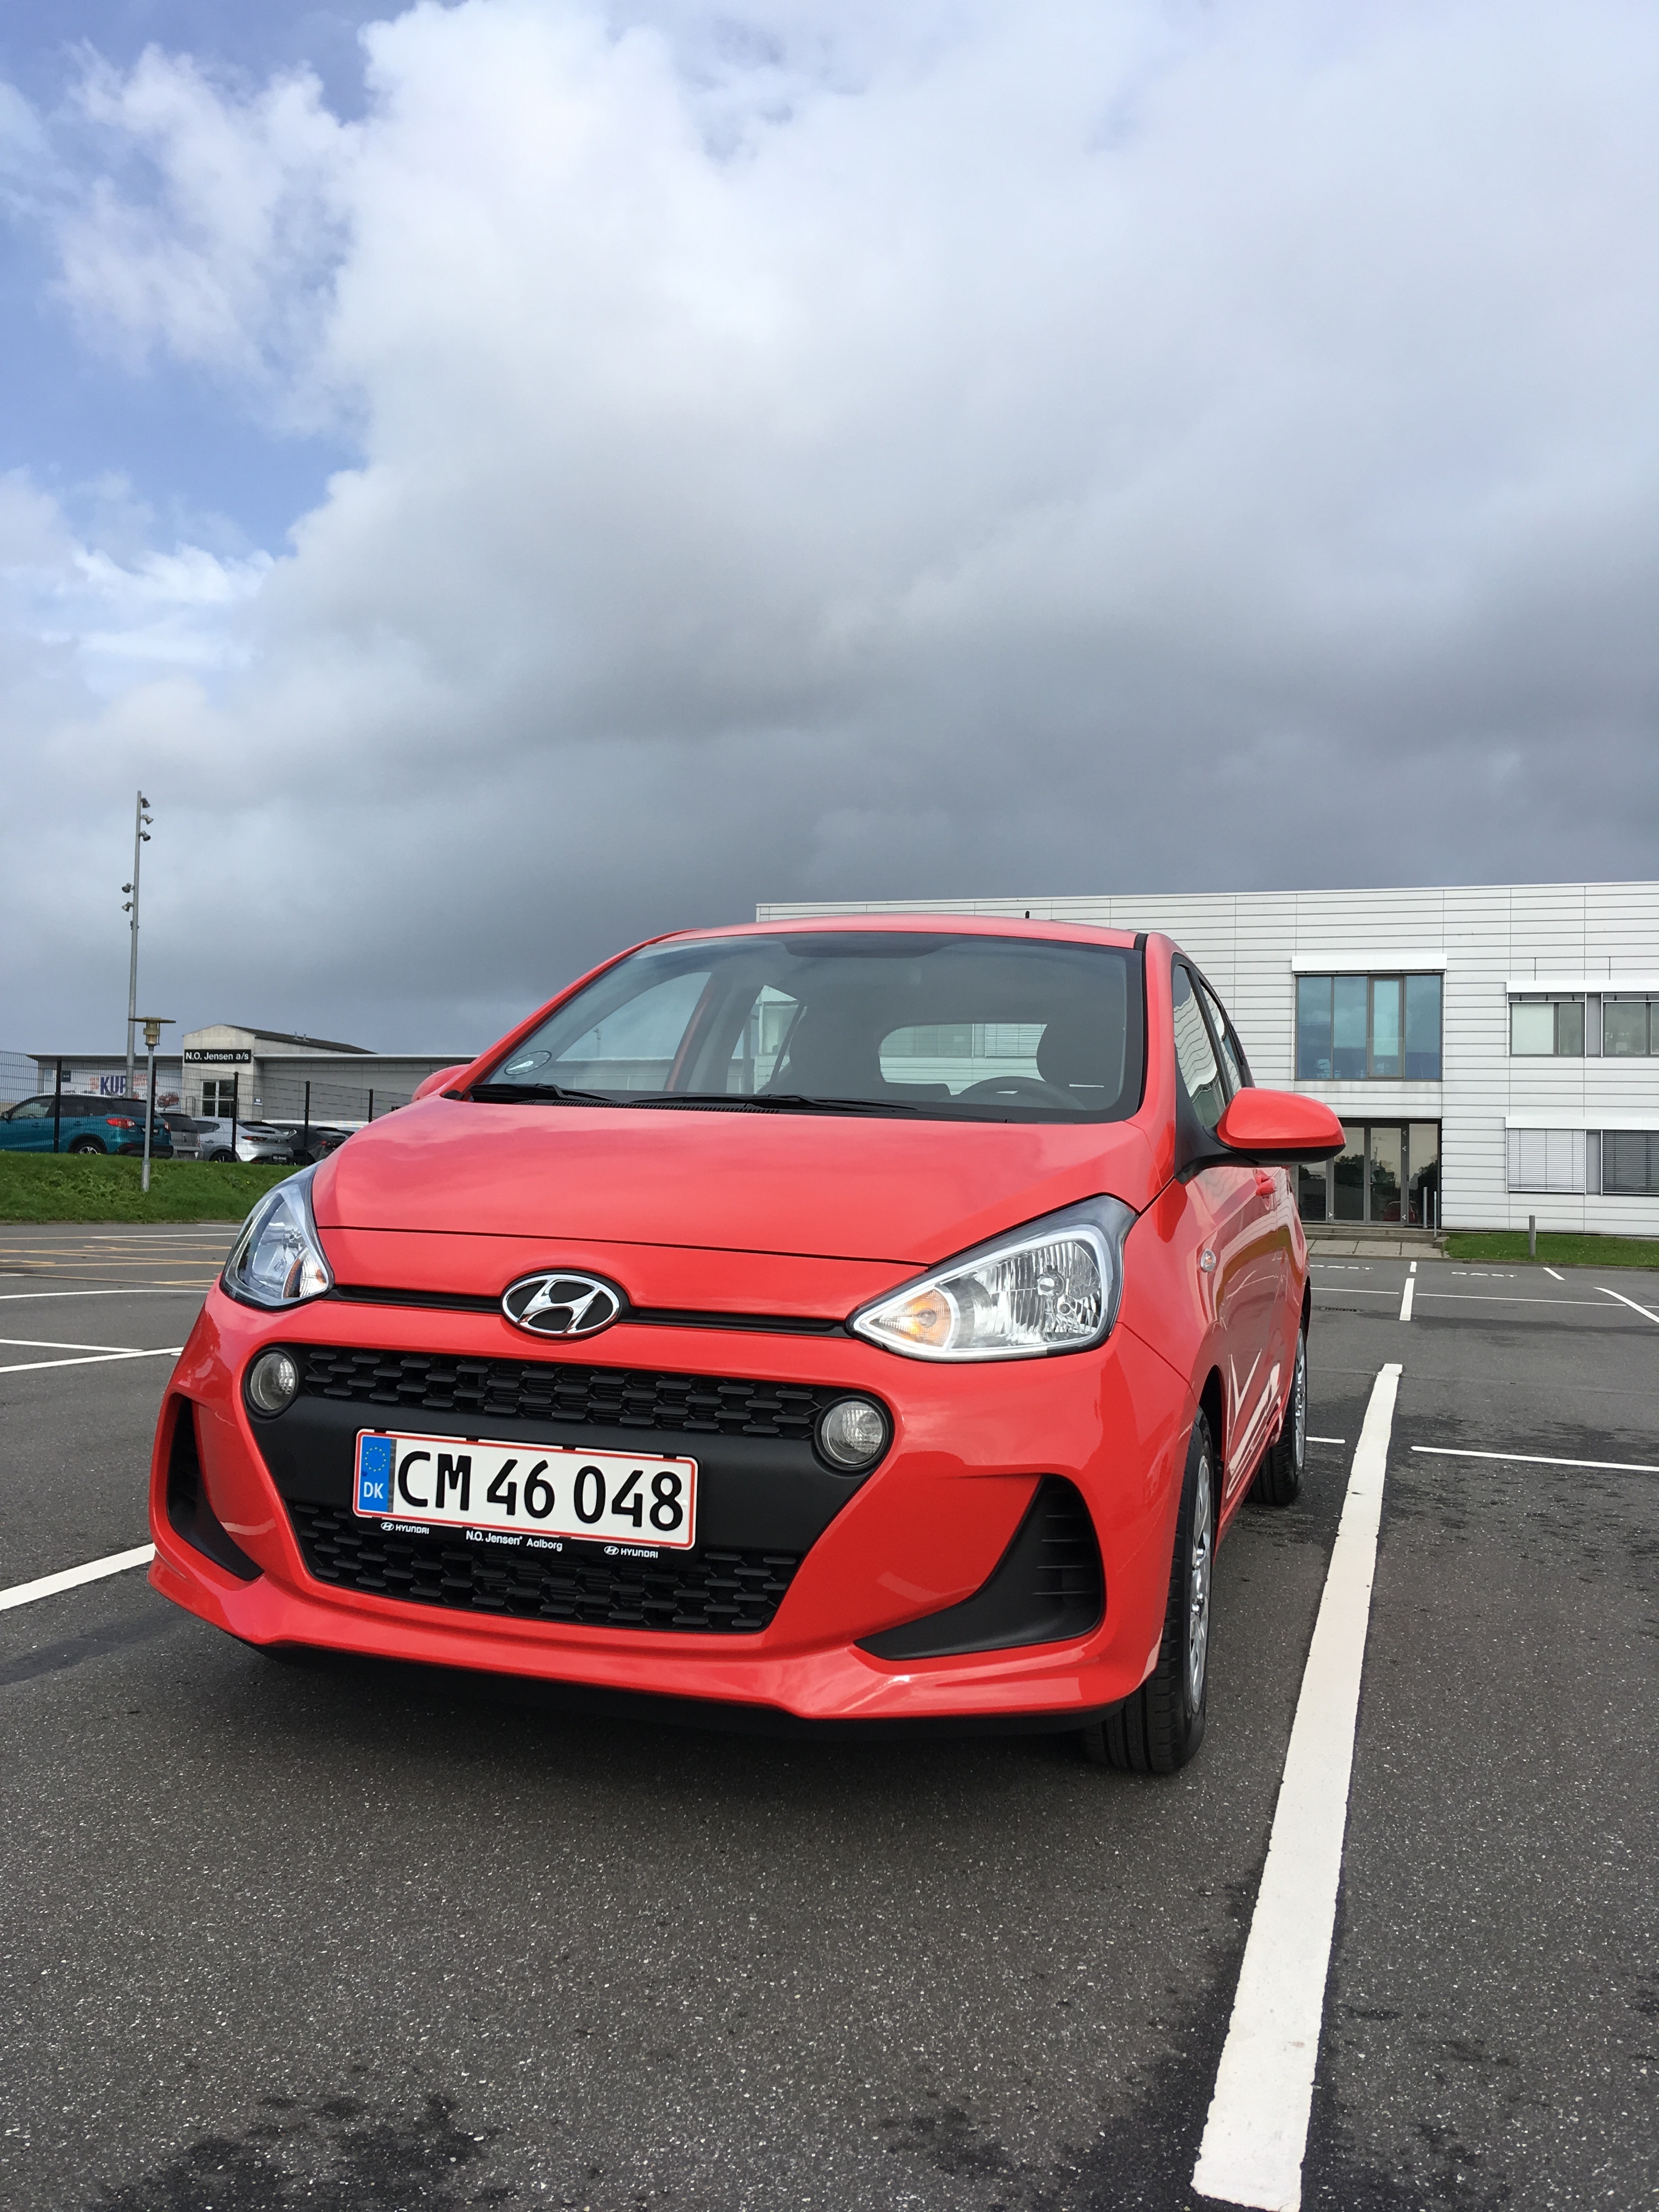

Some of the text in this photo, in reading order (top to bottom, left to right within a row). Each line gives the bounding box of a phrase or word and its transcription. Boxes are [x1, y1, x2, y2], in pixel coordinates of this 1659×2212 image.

[185, 1052, 249, 1060] N.O. Jensen a/s
[363, 1481, 384, 1499] DK
[398, 1451, 684, 1532] CM 46 048
[395, 1524, 430, 1534] HYUNDAI
[466, 1530, 484, 1542] N.O.
[526, 1537, 563, 1552] Aalborg
[620, 1548, 659, 1559] HYUNDAI
